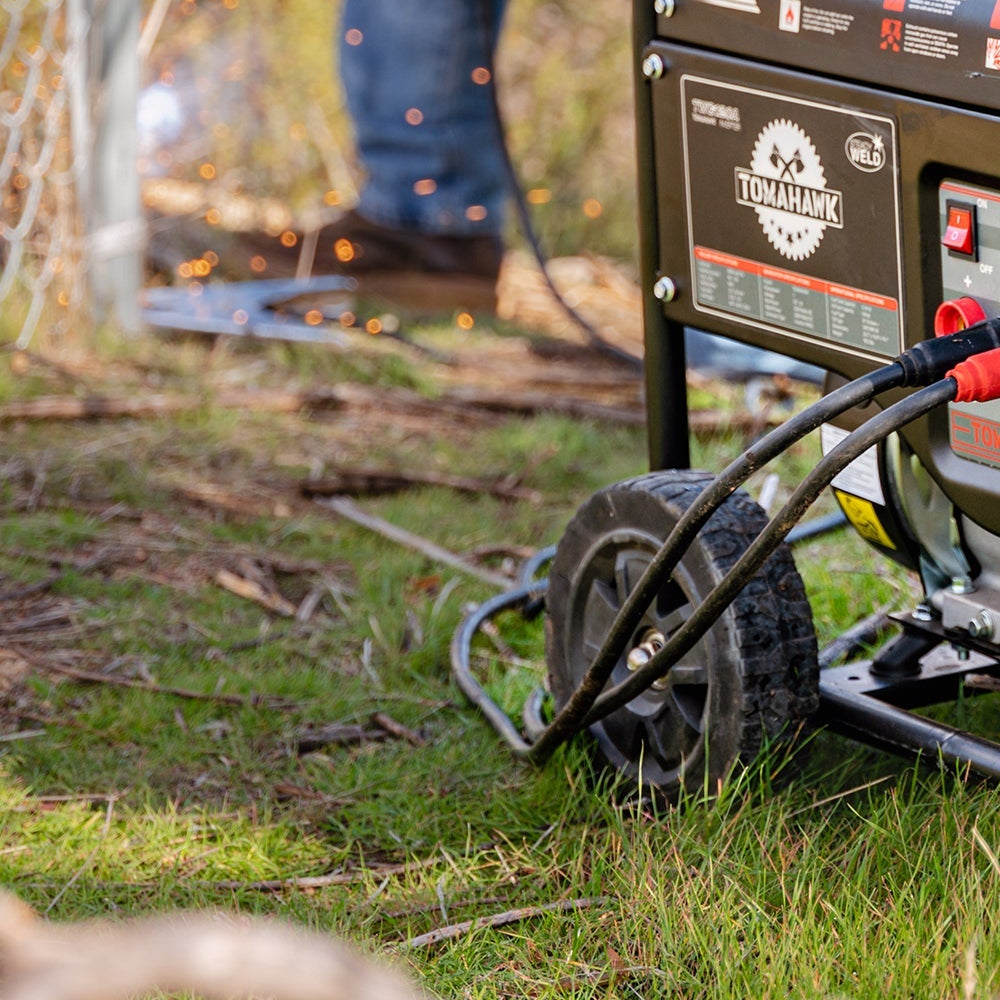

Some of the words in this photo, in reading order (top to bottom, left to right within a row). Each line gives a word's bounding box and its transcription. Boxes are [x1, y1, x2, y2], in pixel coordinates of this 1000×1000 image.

[850, 147, 881, 167] WELD
[738, 174, 840, 223] TOMAHAWK
[976, 198, 988, 209] ON
[979, 263, 994, 276] OFF
